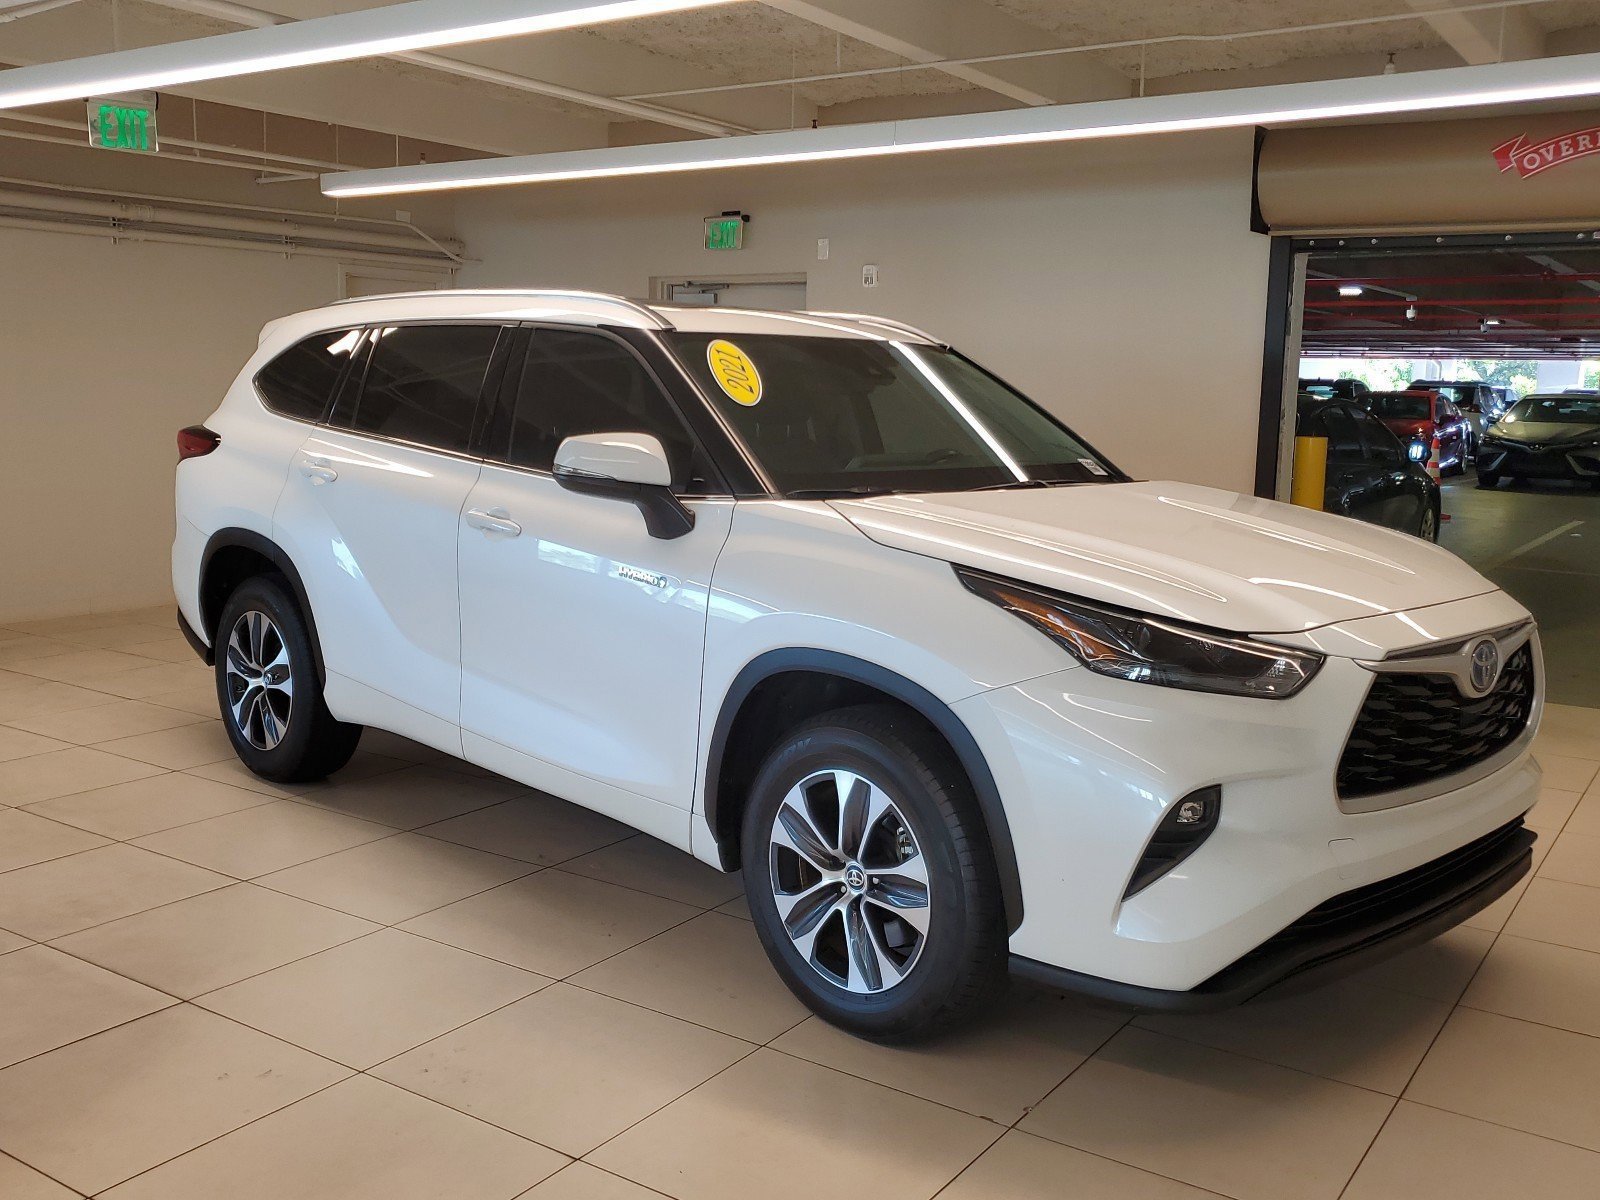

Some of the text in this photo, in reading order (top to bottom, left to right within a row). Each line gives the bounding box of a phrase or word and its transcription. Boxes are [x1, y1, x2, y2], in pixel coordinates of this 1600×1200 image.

[99, 105, 148, 151] EXIT
[1523, 131, 1600, 169] OVER
[709, 221, 738, 249] EXIT
[715, 349, 755, 394] 2021
